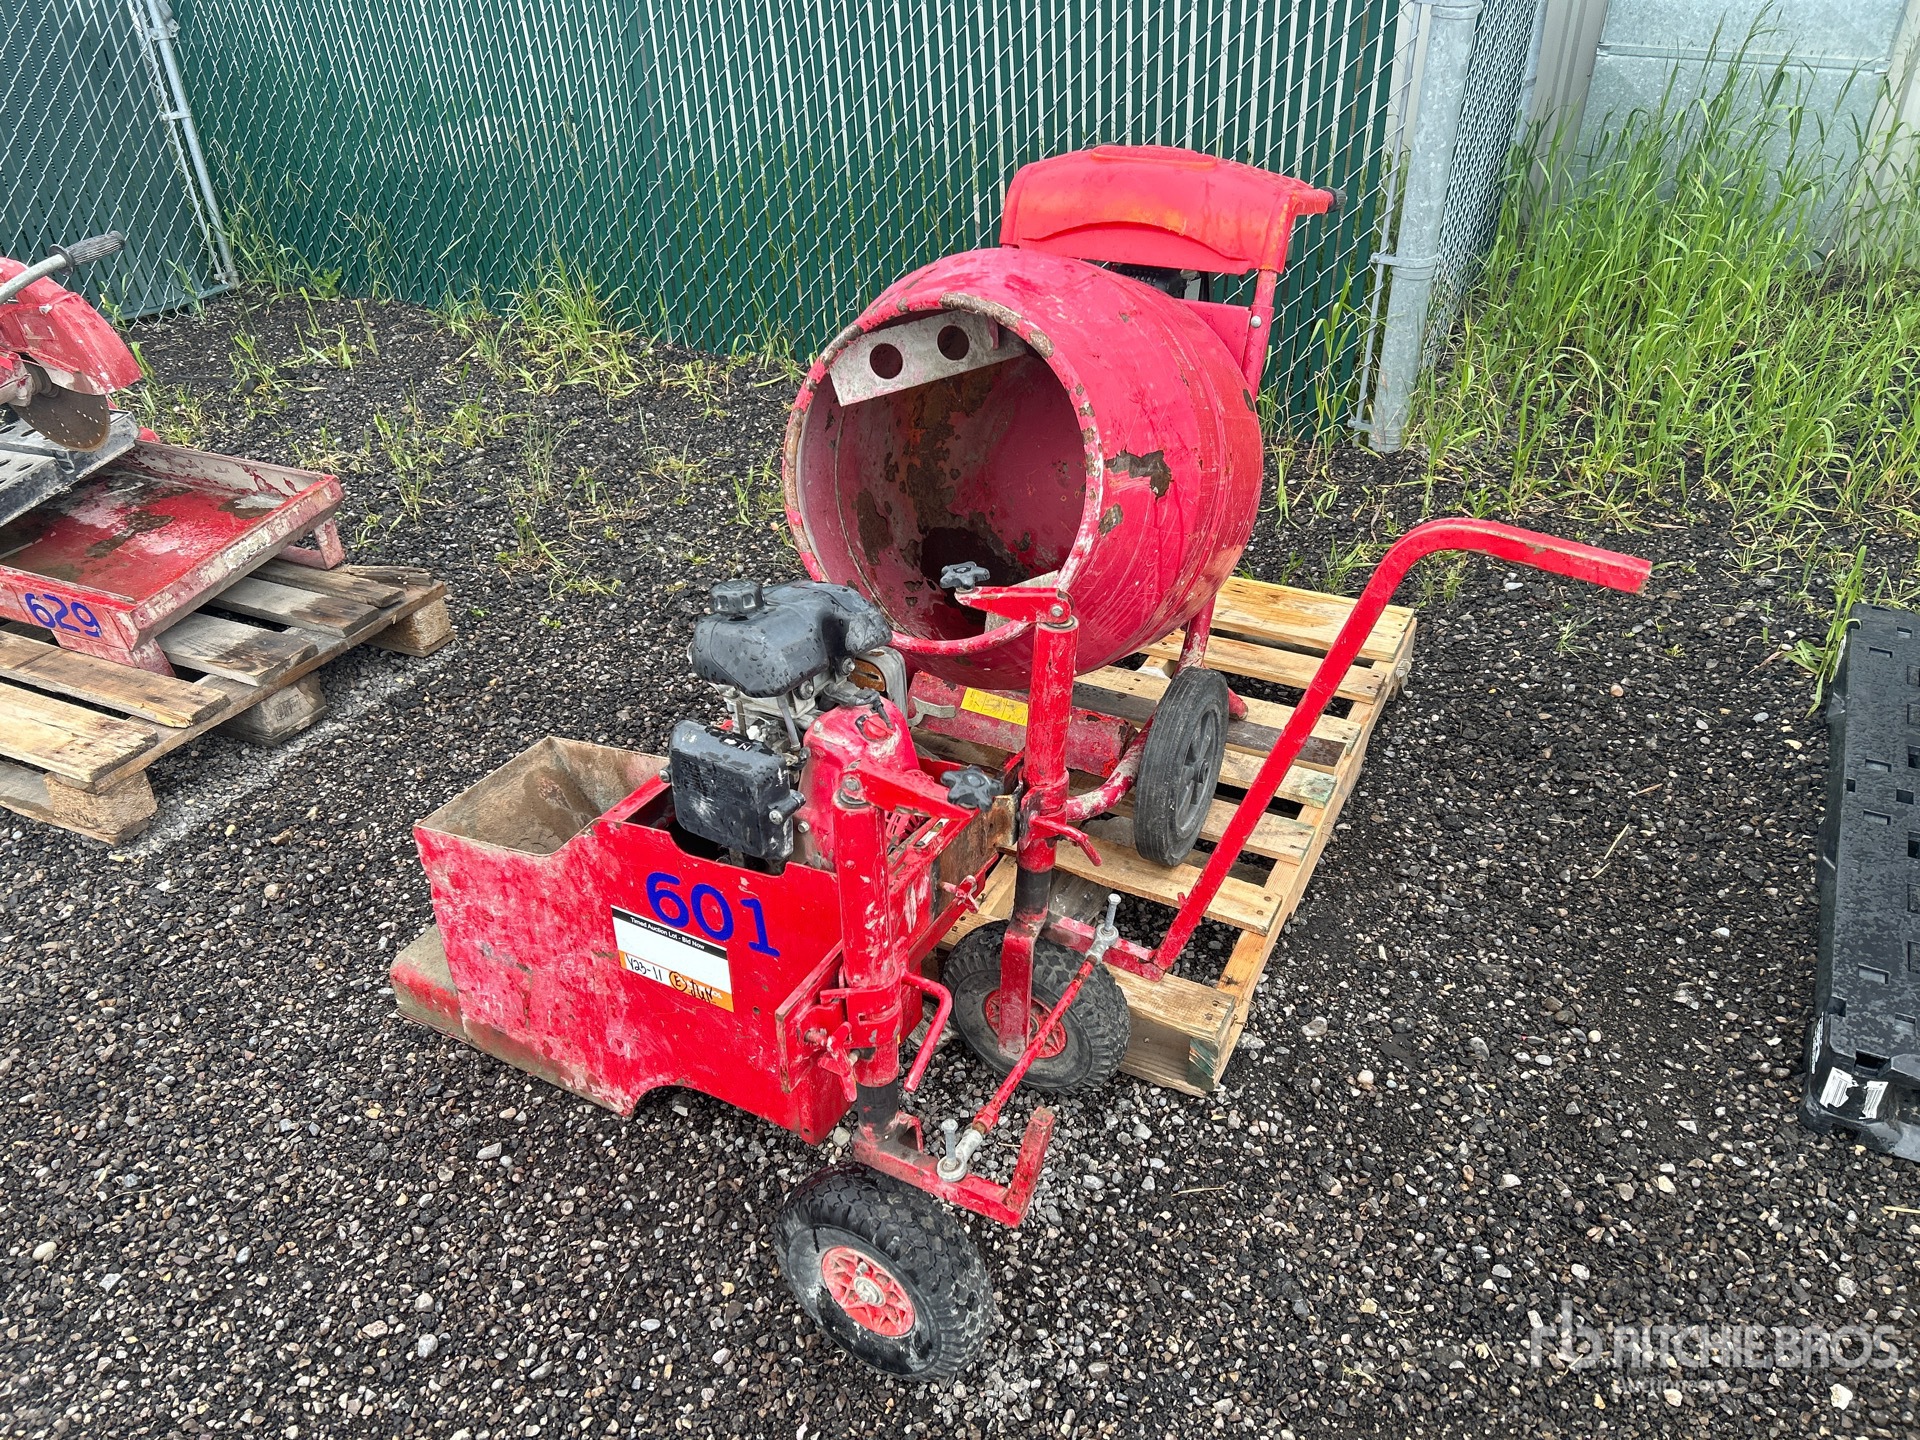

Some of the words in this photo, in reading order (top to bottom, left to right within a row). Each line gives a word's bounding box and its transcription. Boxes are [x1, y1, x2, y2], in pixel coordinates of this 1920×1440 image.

[25, 593, 103, 638] 629
[646, 871, 781, 958] 601
[648, 923, 668, 936] Auction
[691, 940, 705, 950] Now
